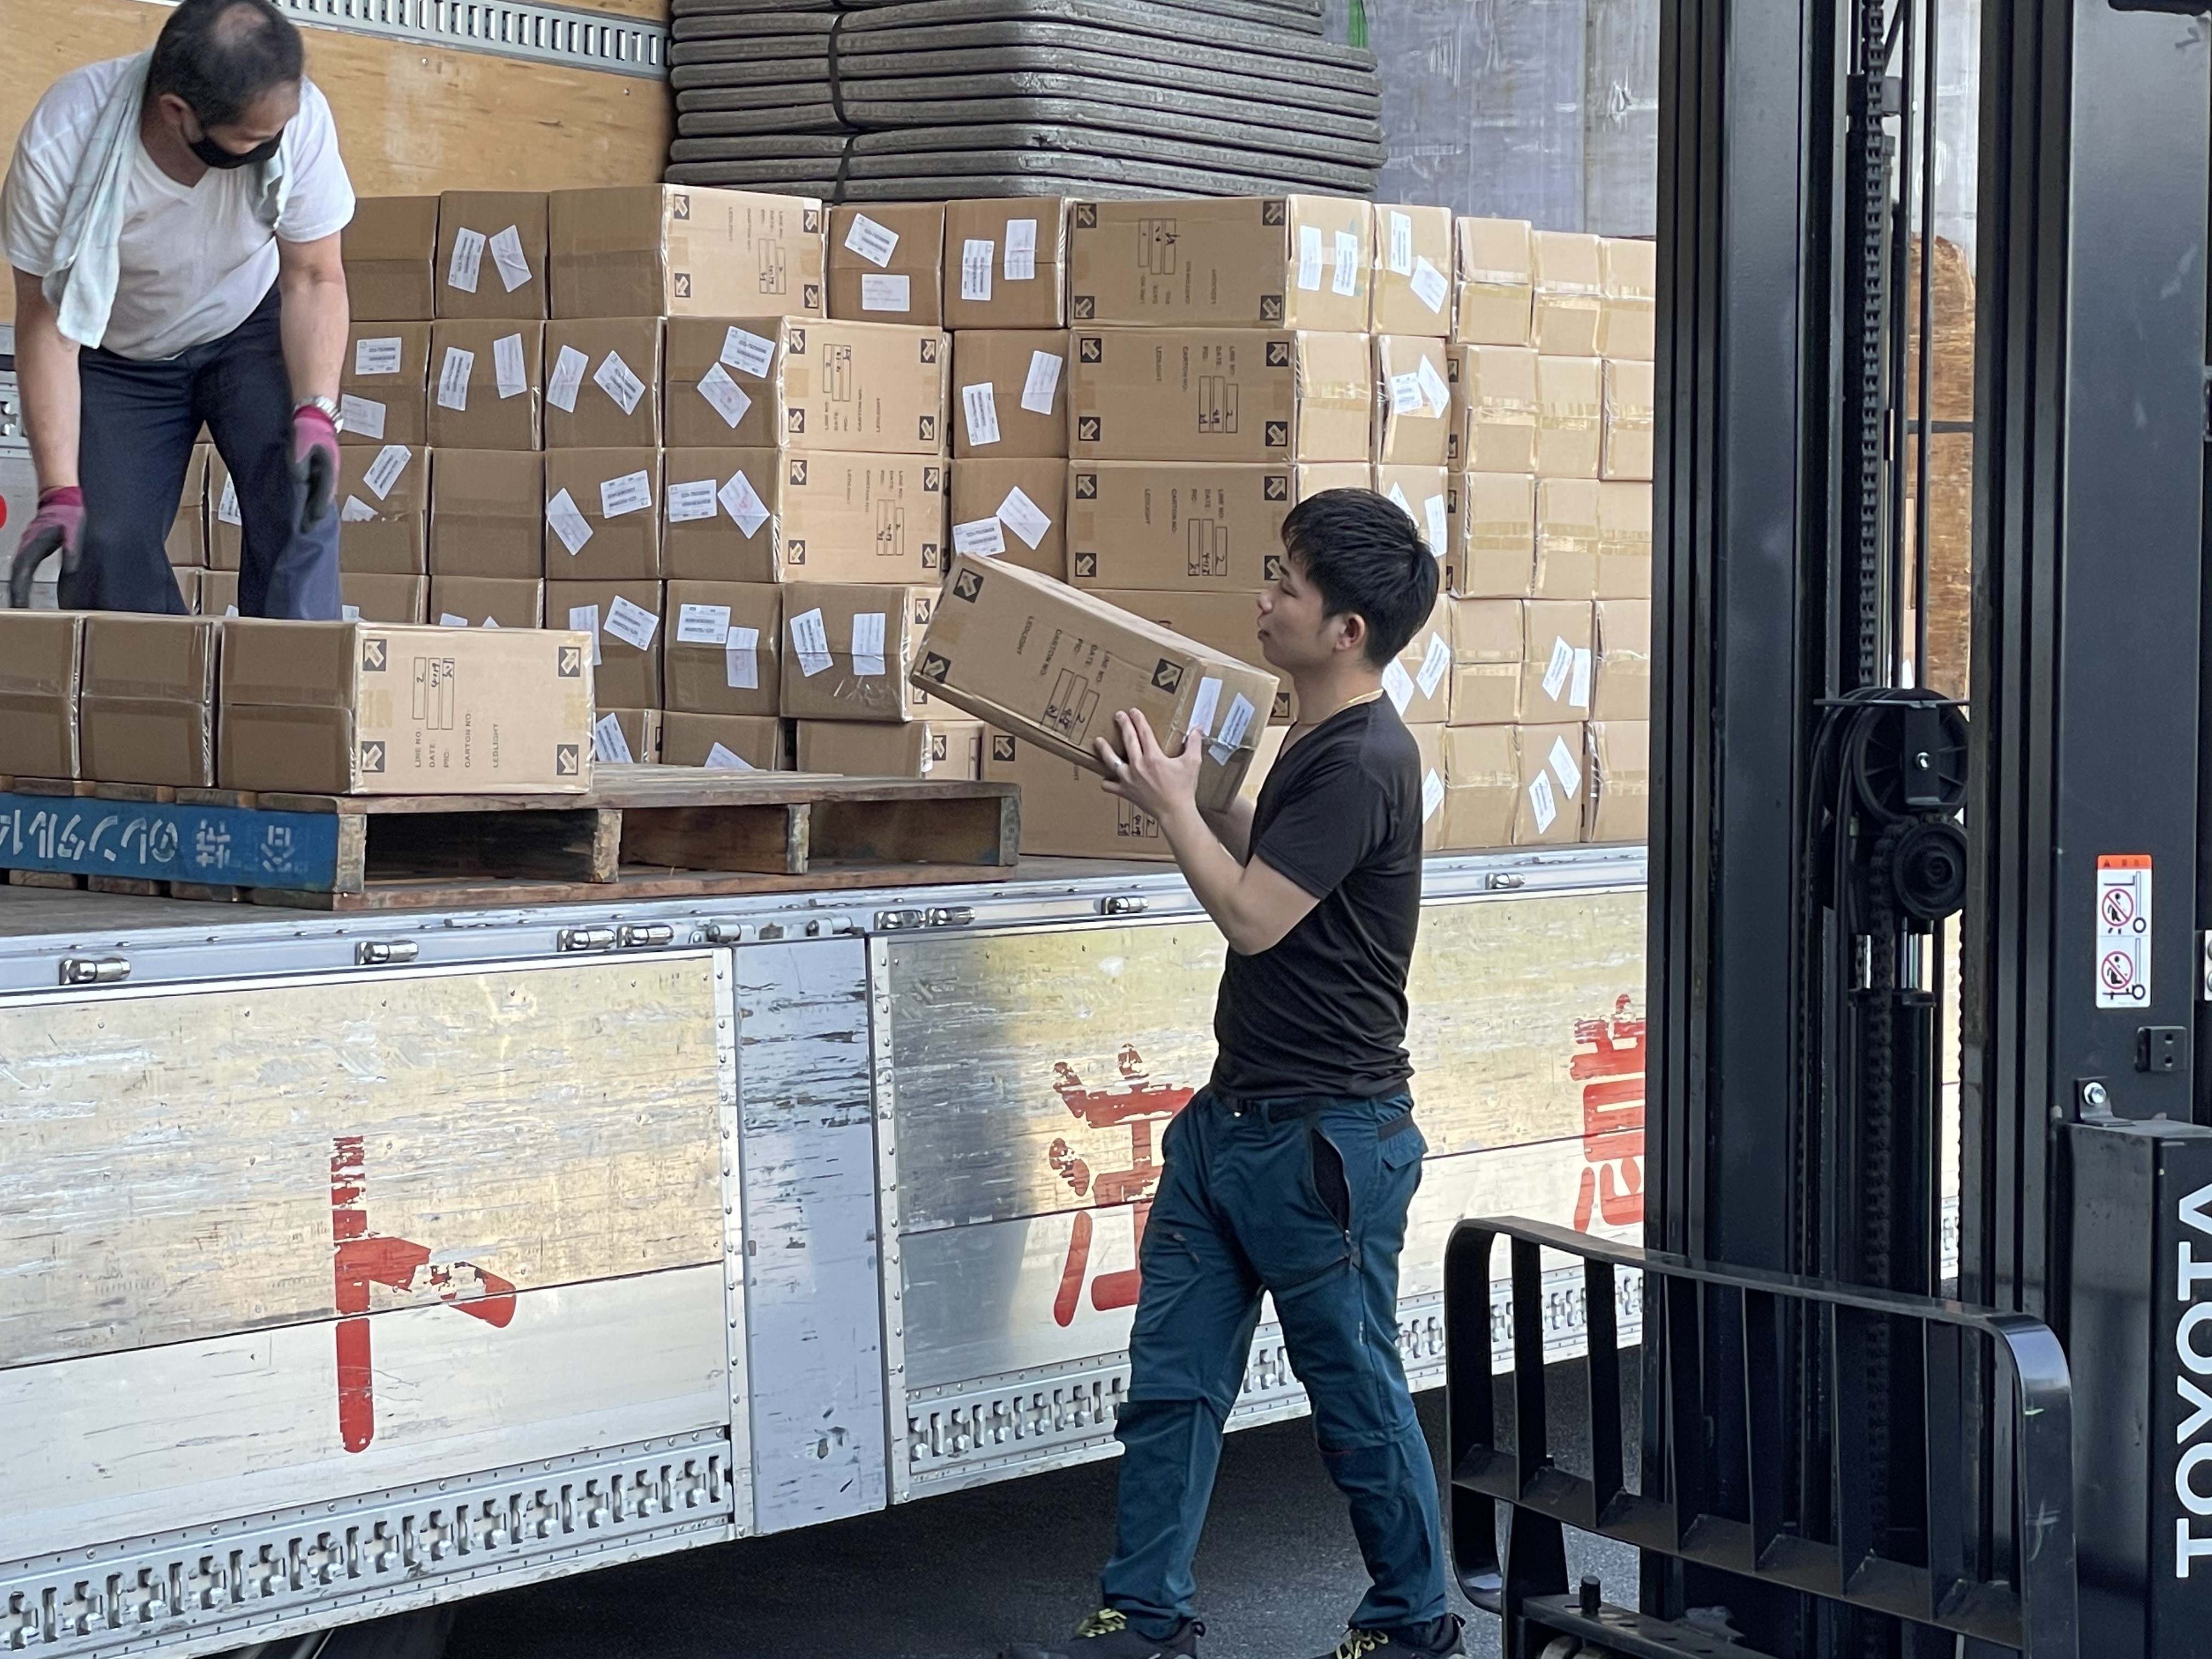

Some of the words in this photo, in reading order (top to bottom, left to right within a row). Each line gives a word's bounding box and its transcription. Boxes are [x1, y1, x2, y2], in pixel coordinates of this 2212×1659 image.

[1226, 410, 1233, 419] 2
[1216, 555, 1224, 565] 2
[416, 673, 424, 683] 2
